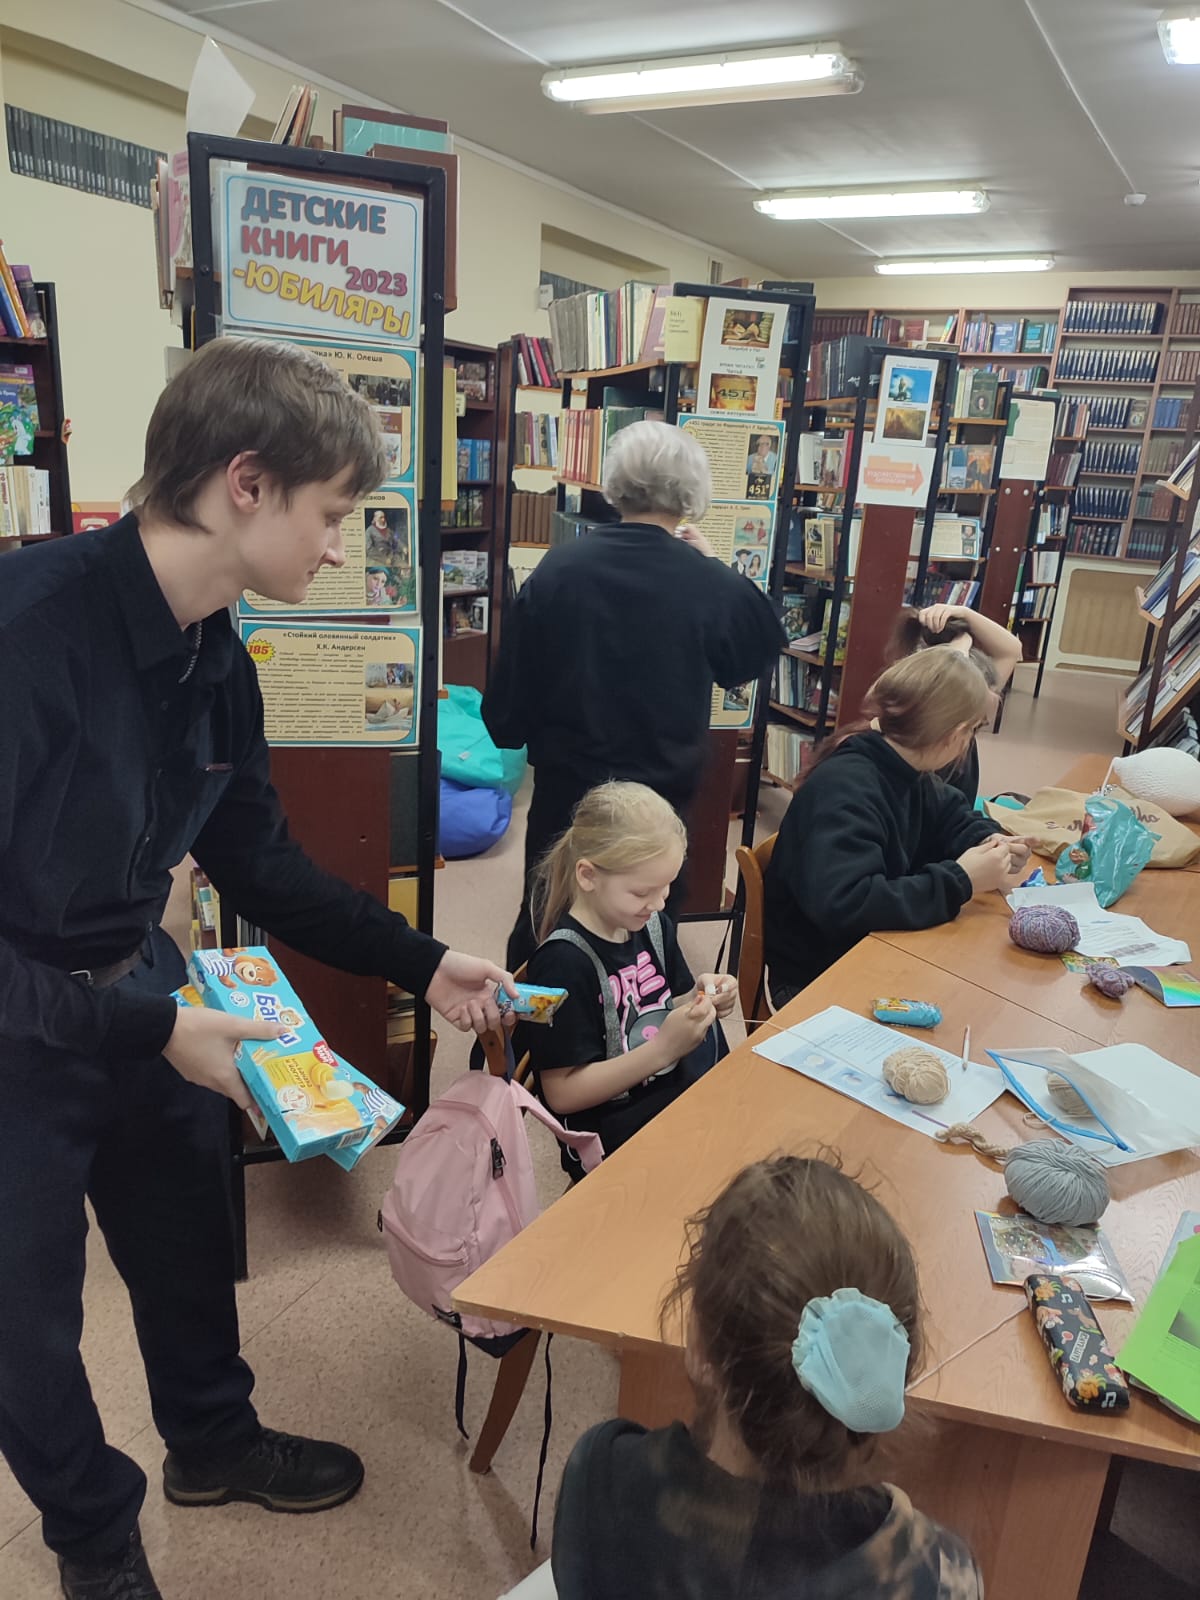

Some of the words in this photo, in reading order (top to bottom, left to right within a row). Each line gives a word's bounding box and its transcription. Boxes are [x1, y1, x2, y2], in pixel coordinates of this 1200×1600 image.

[241, 187, 386, 234] ДЕТСКИЕ
[241, 226, 349, 266] КНИГИ
[345, 266, 408, 297] 2023
[232, 261, 411, 337] -ЮБИЛЯРЫ
[356, 353, 383, 362] Олеша
[248, 645, 269, 655] 185
[282, 631, 317, 639] «Стойкий
[331, 644, 366, 652] Андерсен
[256, 995, 298, 1045] Баи
